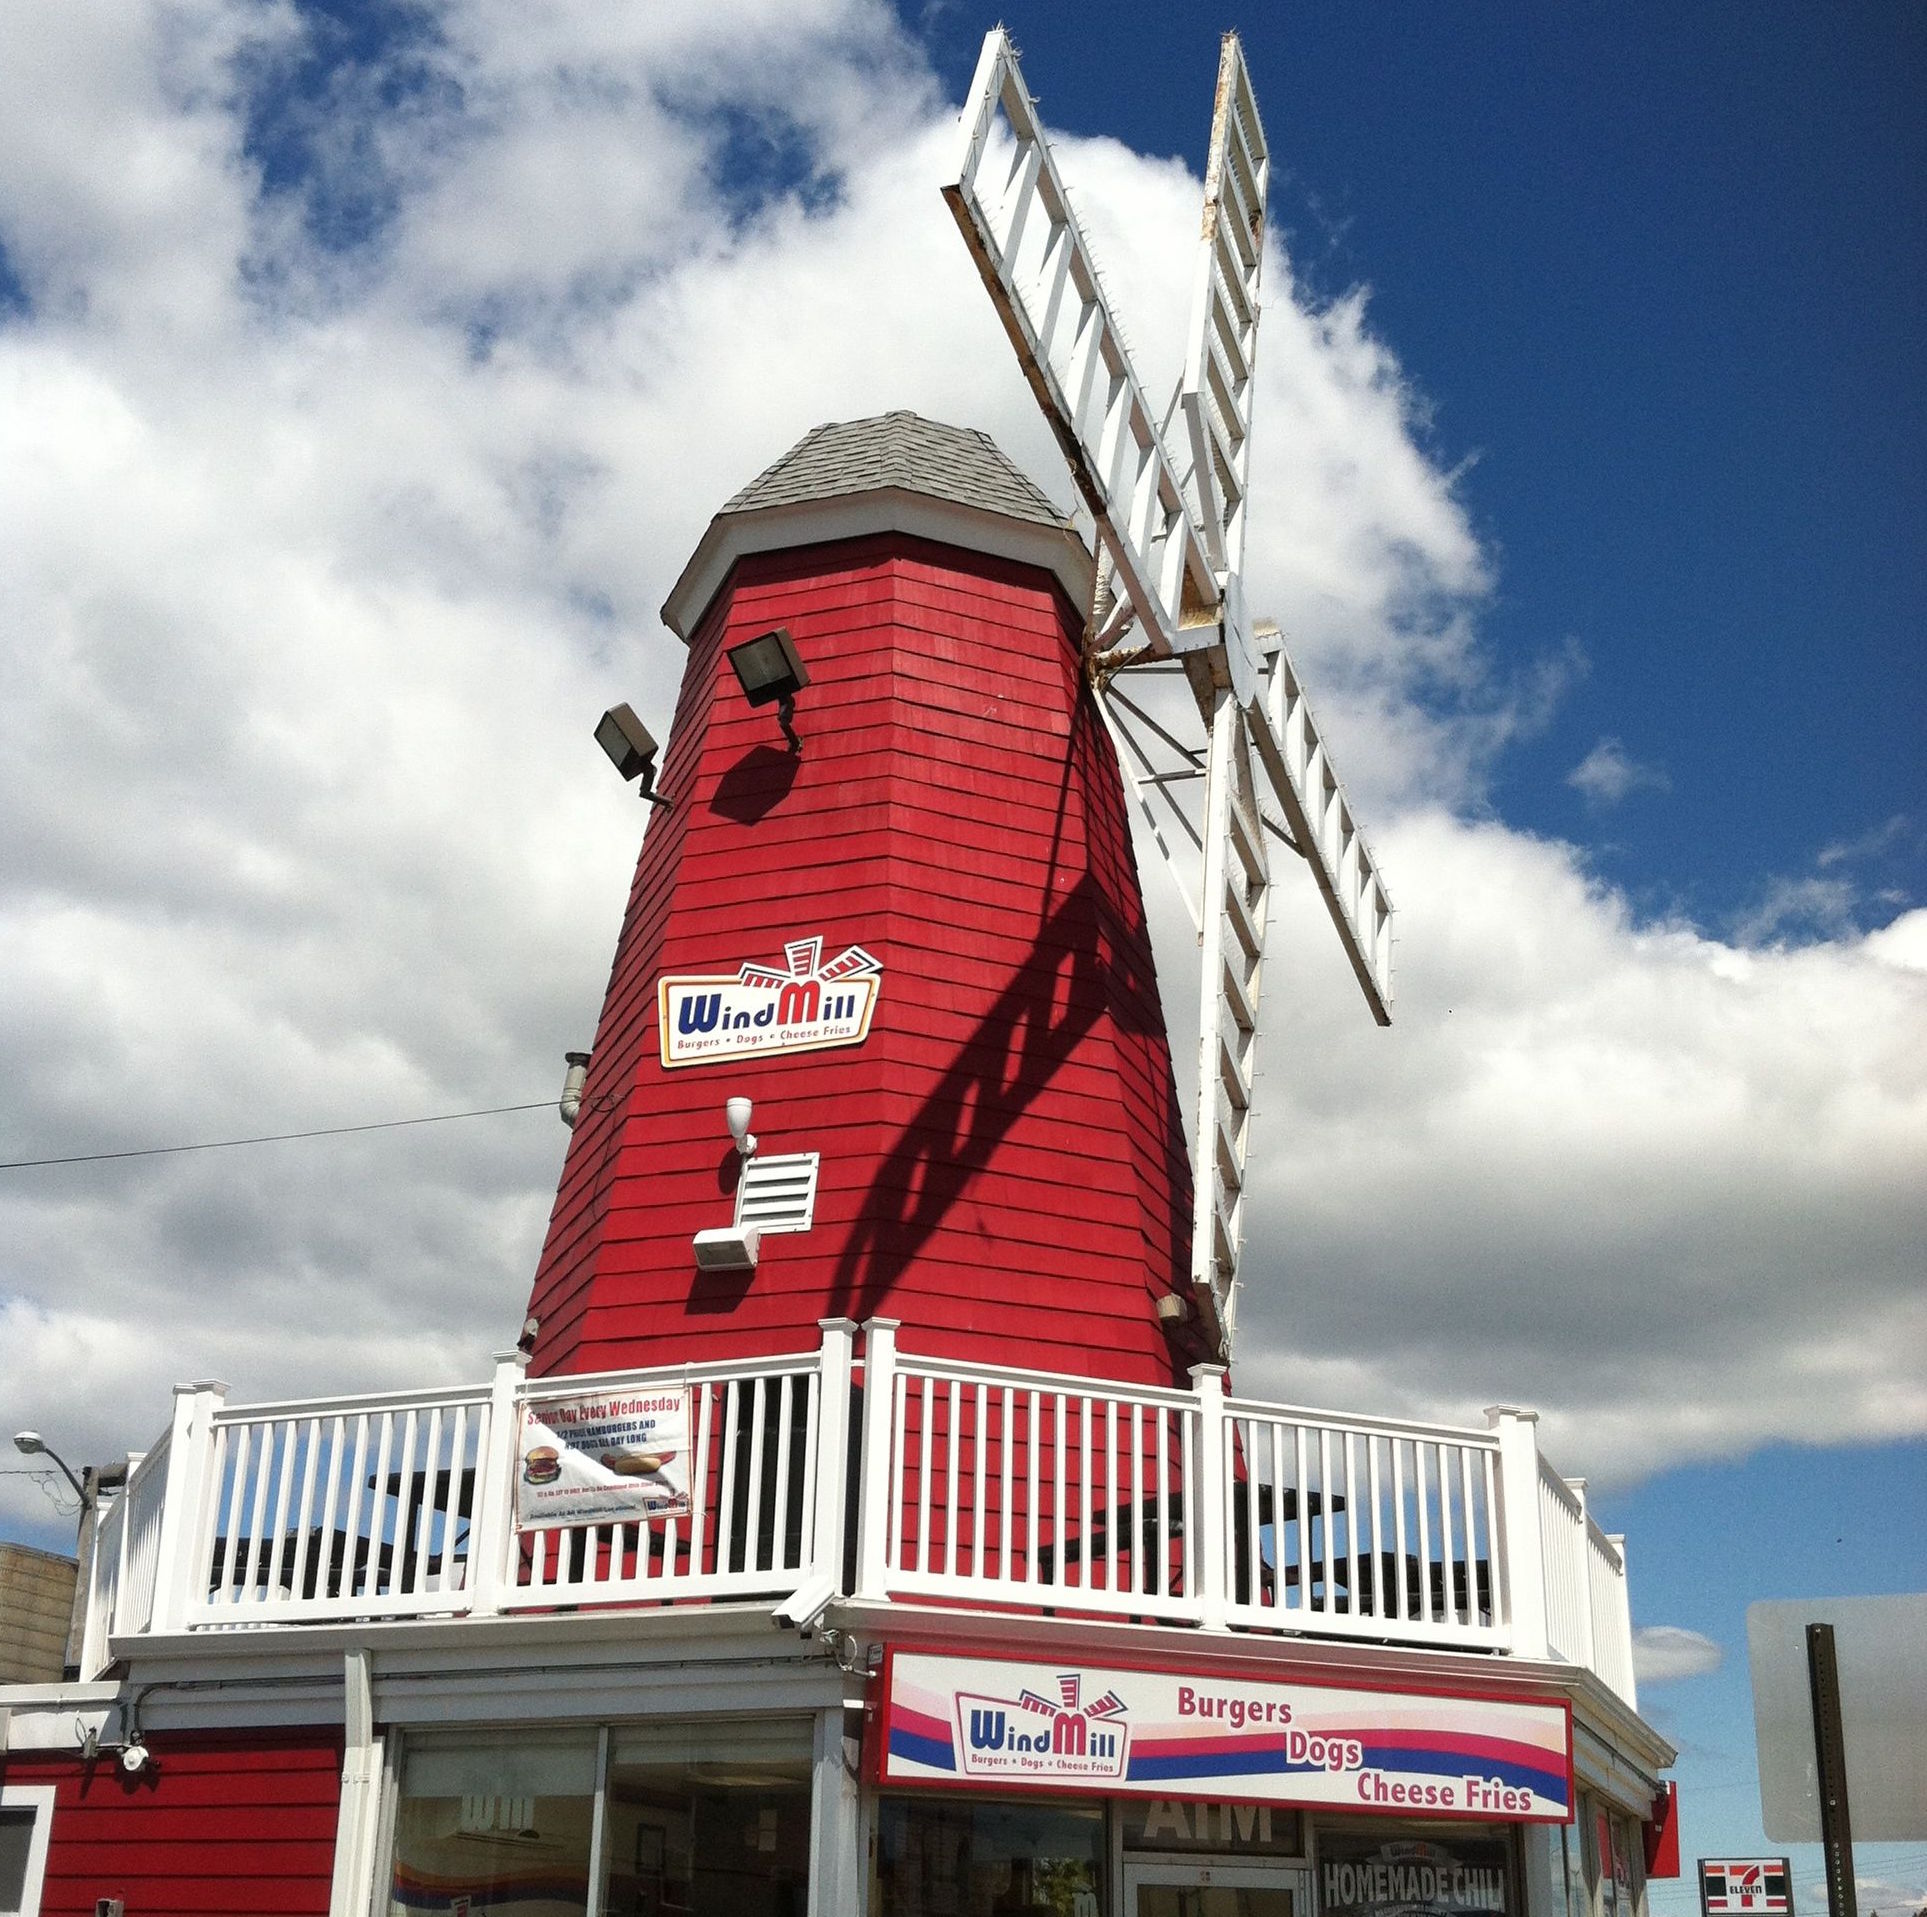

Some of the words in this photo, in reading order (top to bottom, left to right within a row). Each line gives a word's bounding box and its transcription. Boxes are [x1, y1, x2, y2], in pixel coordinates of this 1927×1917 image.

[678, 980, 856, 1035] WindMill
[677, 1038, 720, 1050] Burgers
[736, 1034, 764, 1045] Dogs
[780, 1029, 819, 1040] Cheese
[823, 1025, 851, 1036] Fries
[560, 1408, 577, 1424] Day
[579, 1403, 607, 1420] Every
[609, 1397, 681, 1417] Wednesday
[586, 1421, 638, 1436] HAMBURGERS
[639, 1419, 656, 1429] AND
[611, 1435, 624, 1446] DAY
[627, 1433, 647, 1443] LONG
[1178, 1686, 1293, 1728] Burgers
[970, 1709, 1115, 1758] WindMill
[1290, 1732, 1360, 1771] Dogs
[971, 1754, 1008, 1766] Burgers
[1021, 1757, 1044, 1769] Dogs
[1056, 1760, 1088, 1771] Cheese
[1091, 1762, 1114, 1772] Fries
[1357, 1772, 1455, 1807] Cheese
[1465, 1780, 1532, 1811] Fries
[1324, 1863, 1449, 1908] HOMEMADE
[1453, 1868, 1506, 1913] CHILI
